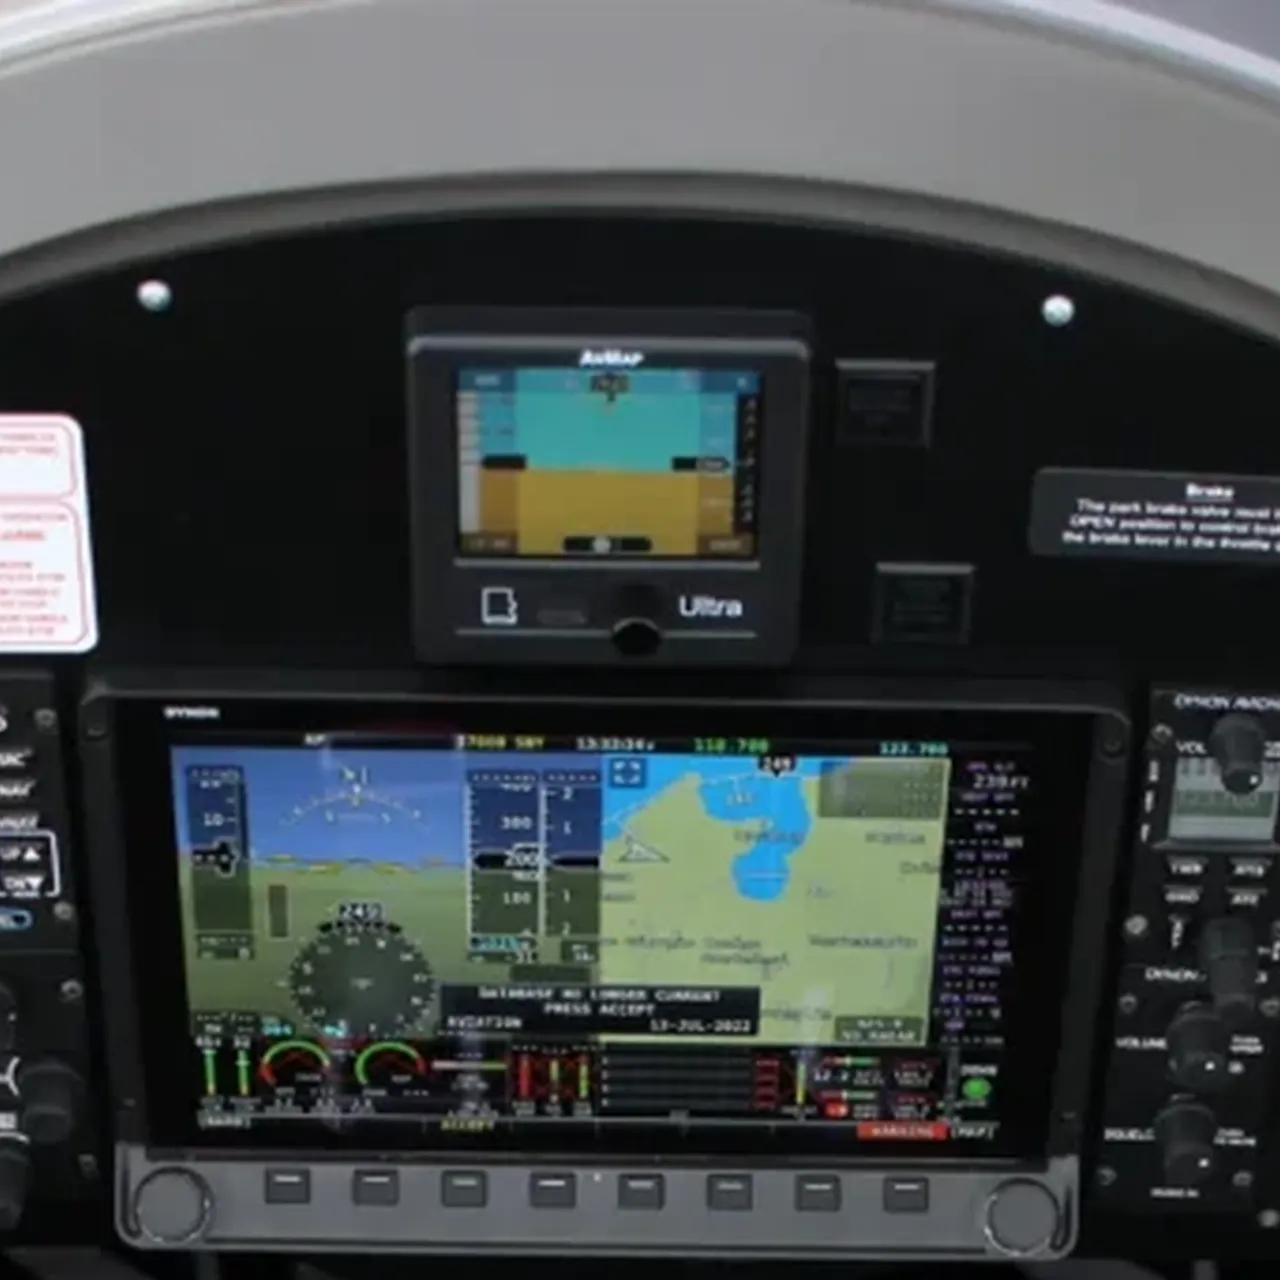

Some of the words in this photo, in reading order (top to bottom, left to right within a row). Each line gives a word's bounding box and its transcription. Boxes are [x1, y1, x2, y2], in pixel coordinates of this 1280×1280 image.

[1185, 482, 1235, 500] Brake
[678, 595, 744, 619] Ultra
[1175, 739, 1208, 755] VOL
[543, 1003, 591, 1016] PRESS
[599, 1003, 656, 1016] ACCEPT
[446, 1016, 523, 1030] AVIATION
